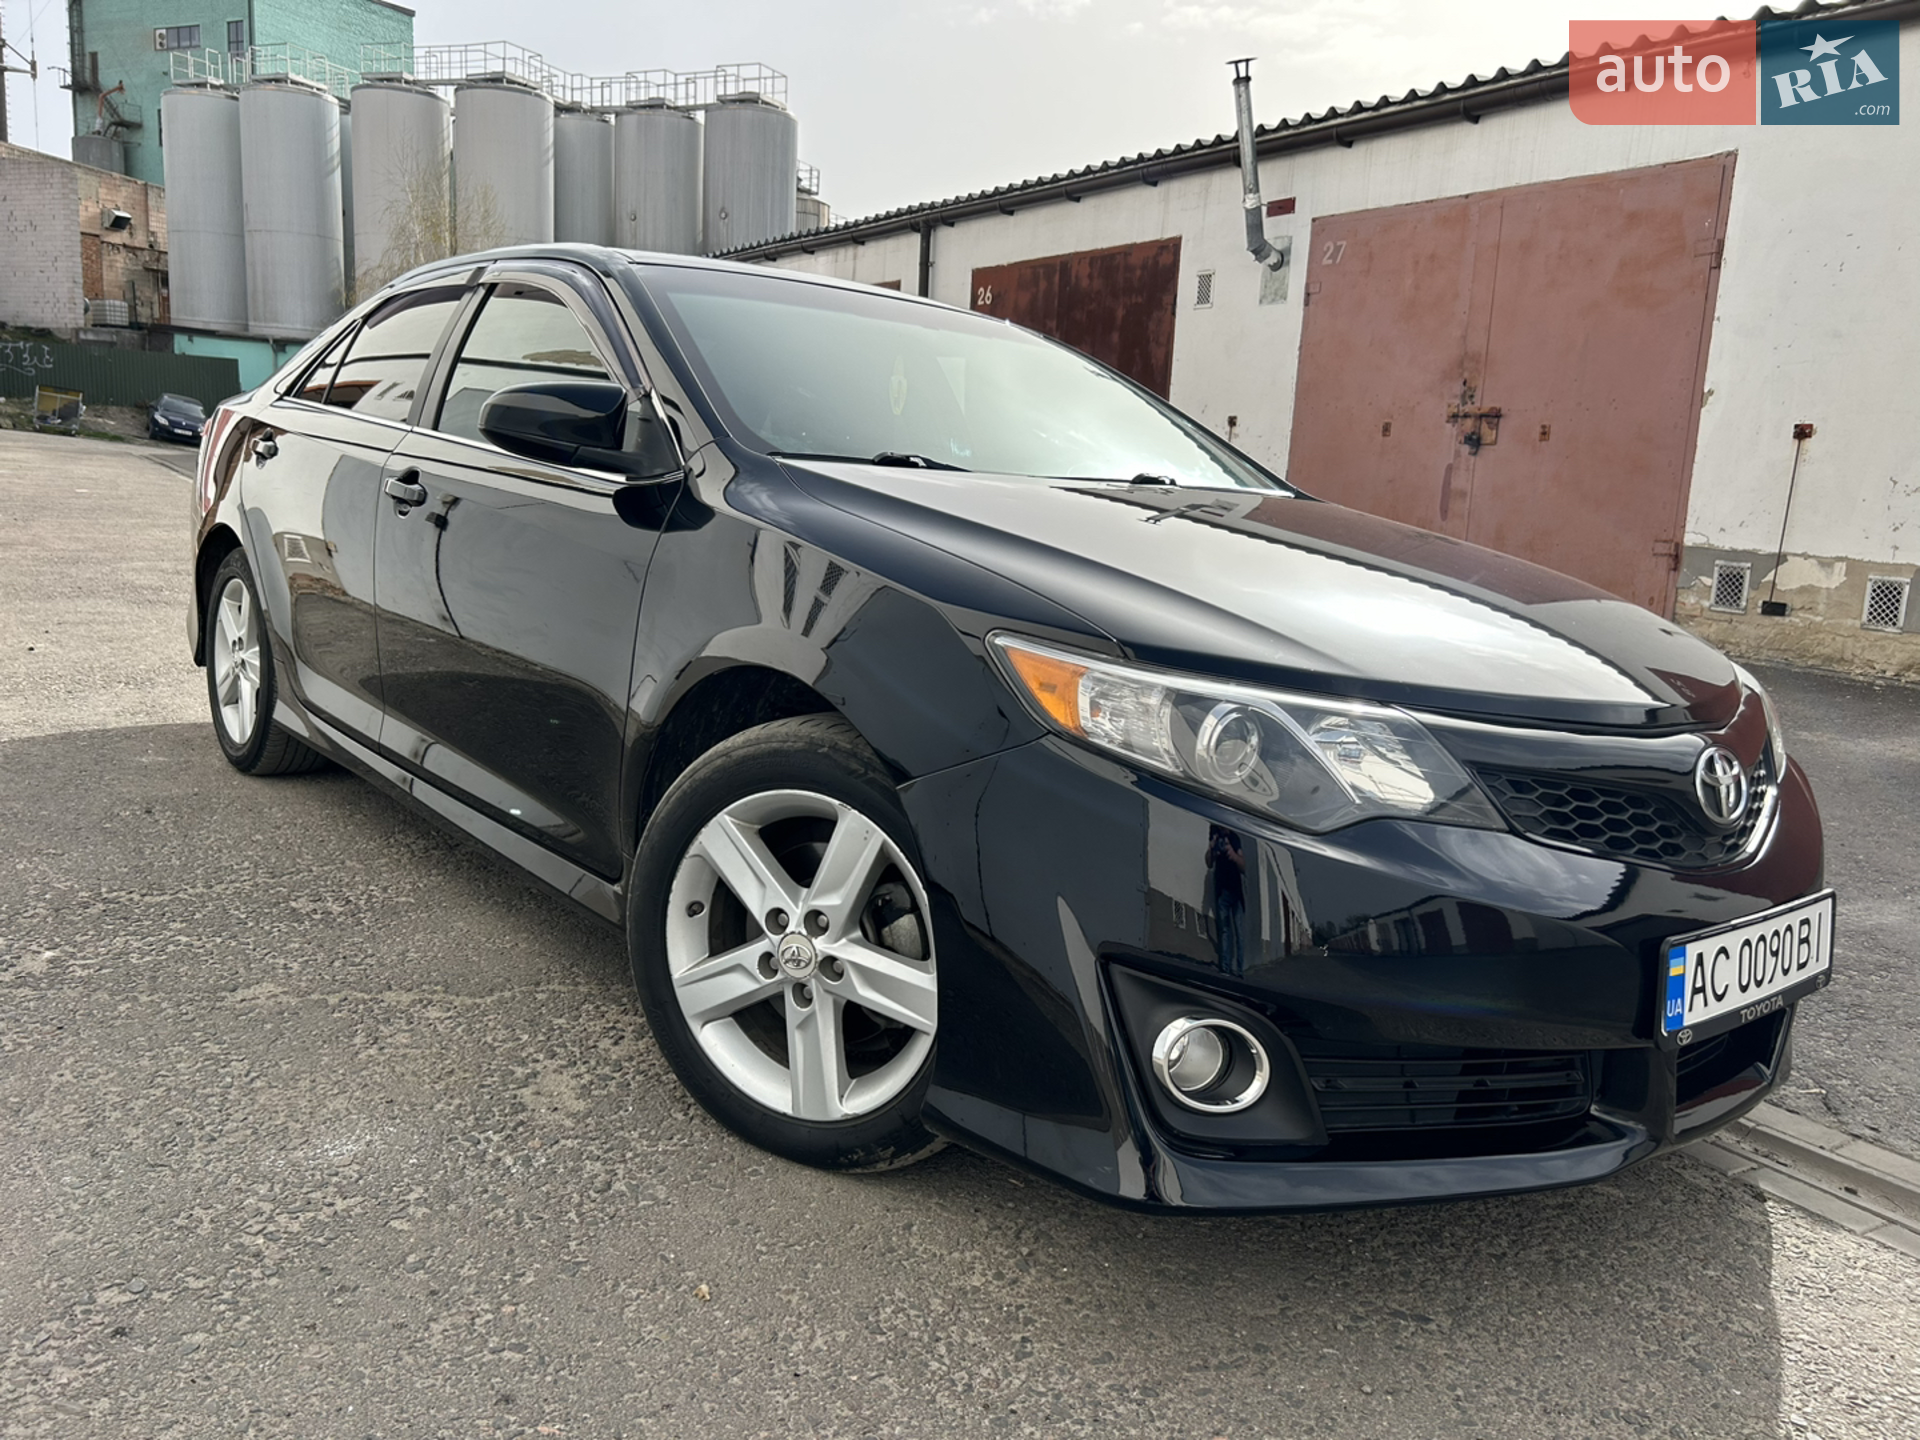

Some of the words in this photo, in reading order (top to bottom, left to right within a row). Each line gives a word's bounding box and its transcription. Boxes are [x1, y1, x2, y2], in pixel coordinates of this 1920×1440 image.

[1321, 240, 1347, 265] 27
[977, 285, 993, 305] 26
[1688, 946, 1730, 1012] AC
[1667, 998, 1683, 1017] UA
[1740, 995, 1784, 1023] TOYOTA
